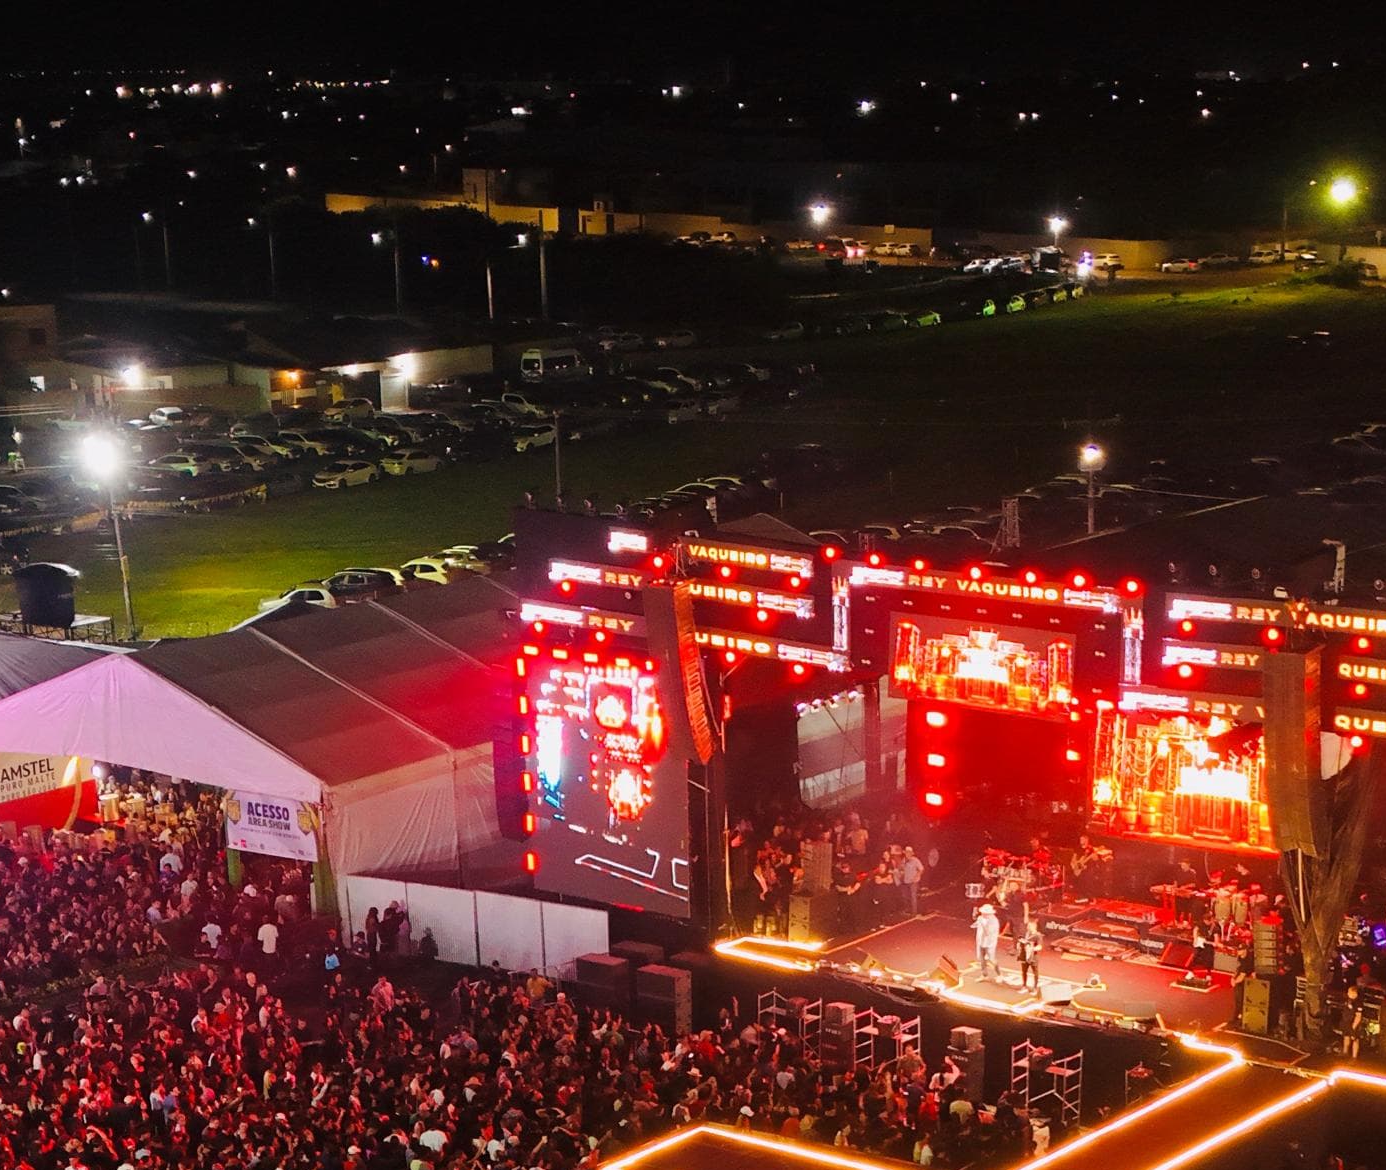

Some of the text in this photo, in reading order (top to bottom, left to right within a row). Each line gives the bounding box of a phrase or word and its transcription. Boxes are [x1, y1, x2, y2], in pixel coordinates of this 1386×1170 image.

[688, 544, 767, 566] VAQUEIRO
[604, 572, 753, 603] REY UEIRO
[908, 574, 1059, 601] REY VAQUEIRO
[1236, 606, 1281, 622] REY
[588, 614, 771, 654] REY UEIRO
[1220, 652, 1260, 667] REY
[1193, 700, 1243, 717] REY
[0, 758, 55, 783] AMSTEL
[0, 771, 56, 793] PURO MALTE
[246, 801, 290, 821] ACESSO
[268, 820, 291, 832] SHOW
